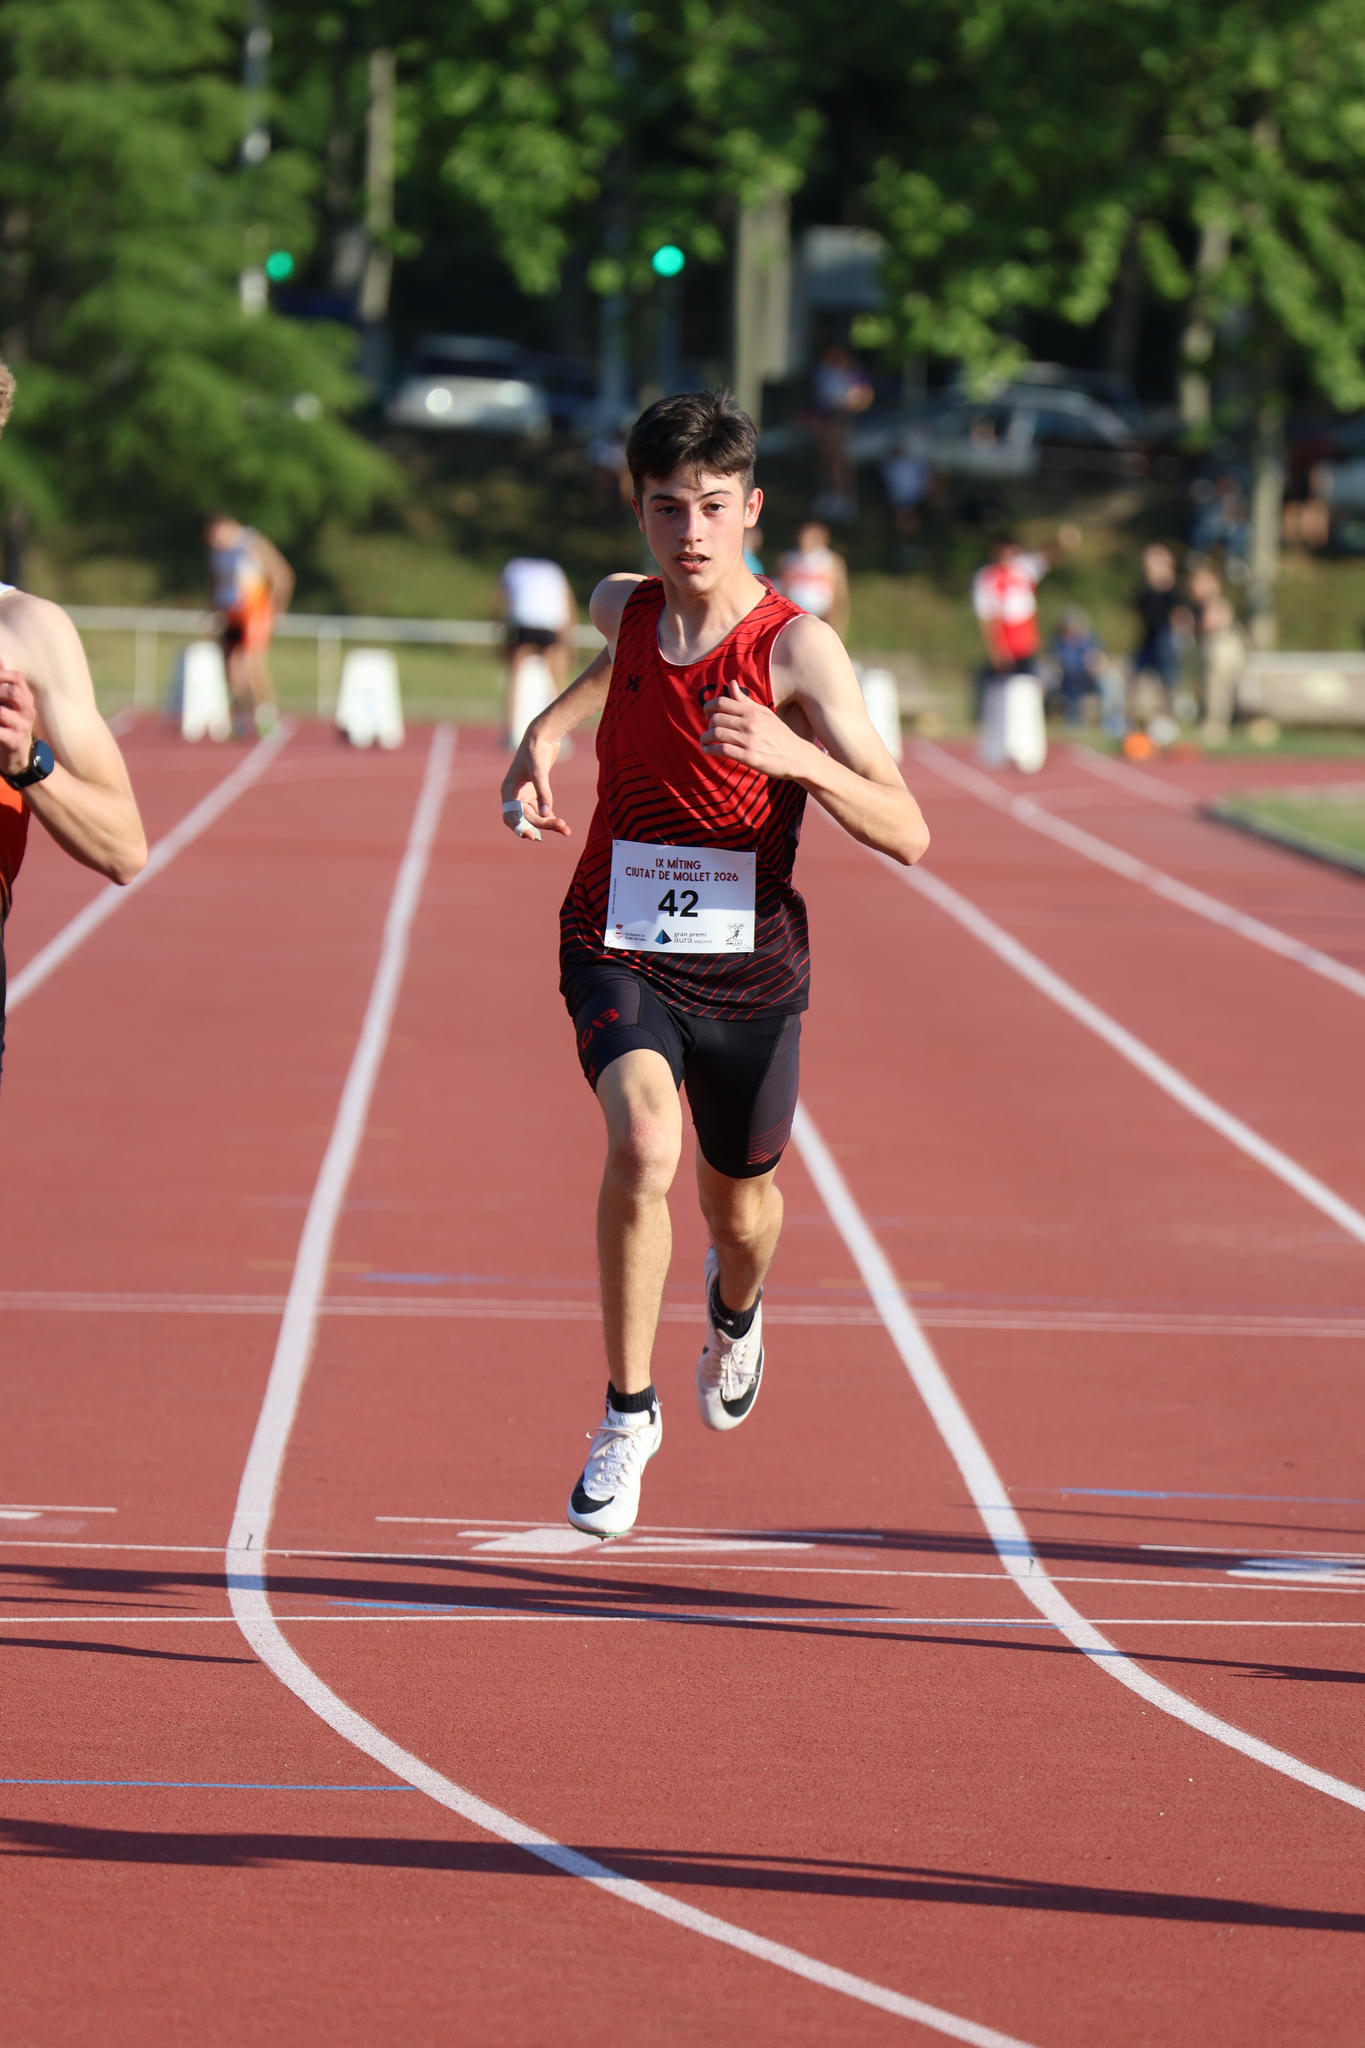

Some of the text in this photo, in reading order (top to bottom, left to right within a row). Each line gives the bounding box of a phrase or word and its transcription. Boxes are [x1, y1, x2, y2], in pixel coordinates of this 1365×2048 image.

[655, 858, 701, 869] IX MÍTING
[625, 867, 739, 882] CIUTAT DE MOLLET 2026
[657, 889, 699, 917] 42
